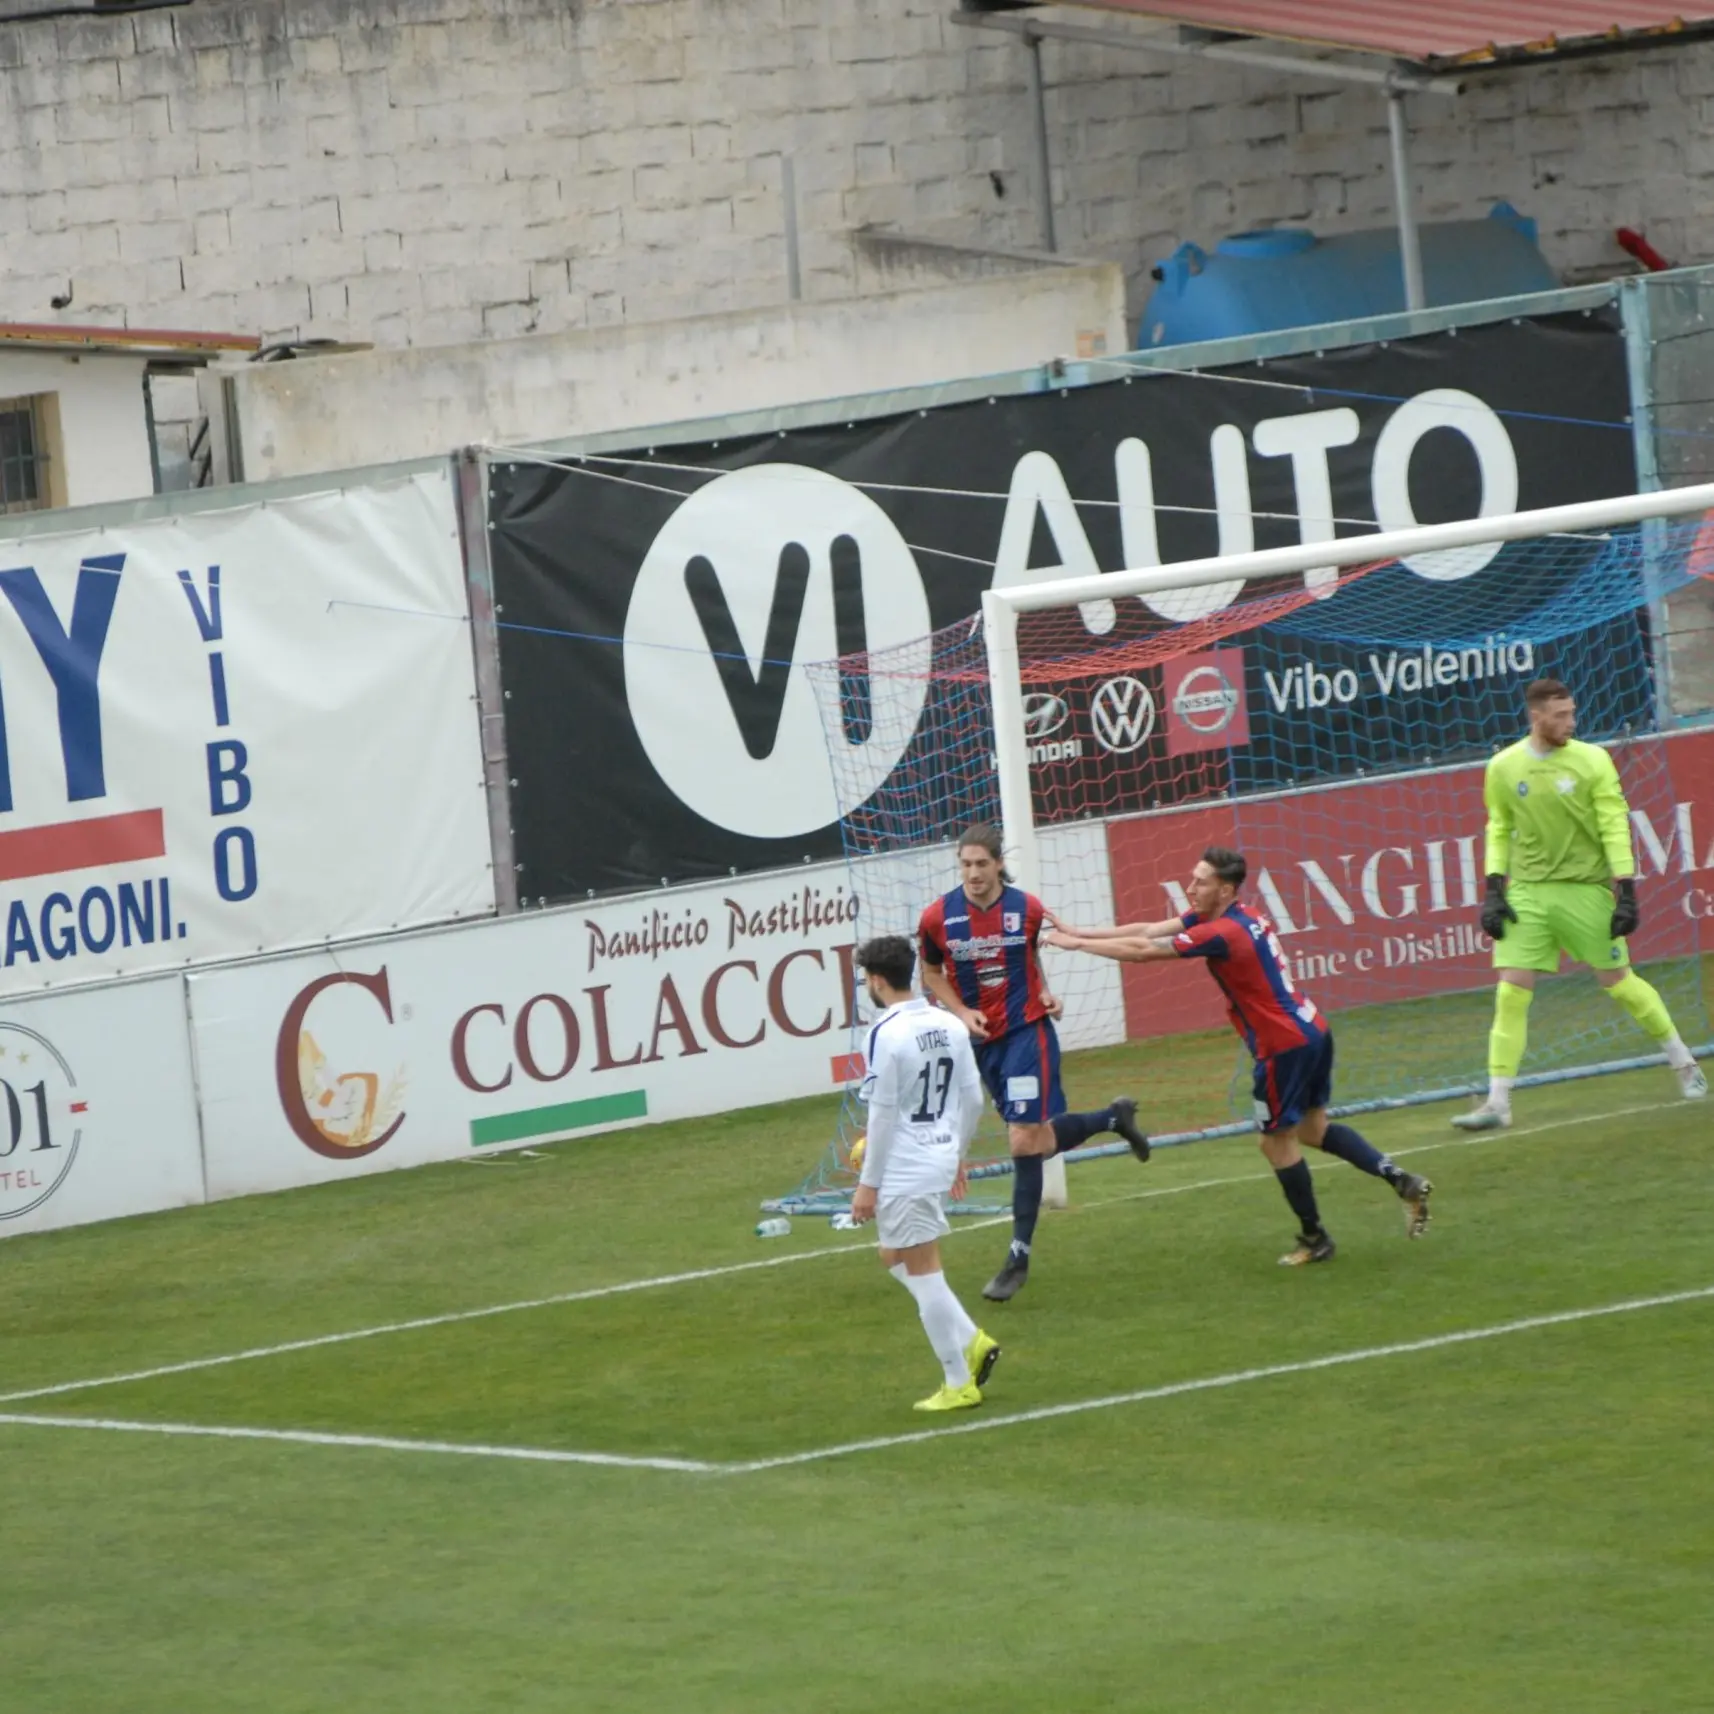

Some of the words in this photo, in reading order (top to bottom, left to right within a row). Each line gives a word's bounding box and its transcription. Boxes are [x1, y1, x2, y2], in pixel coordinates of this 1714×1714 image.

[684, 533, 874, 761] VI
[986, 388, 1519, 635] AUTO
[0, 553, 127, 813] Y
[1264, 662, 1358, 713] Vibo
[177, 565, 259, 902] VIBO
[1629, 801, 1714, 880] M
[0, 877, 187, 967] AGONI.
[584, 909, 709, 973] Panificio
[723, 885, 860, 950] Pastificio
